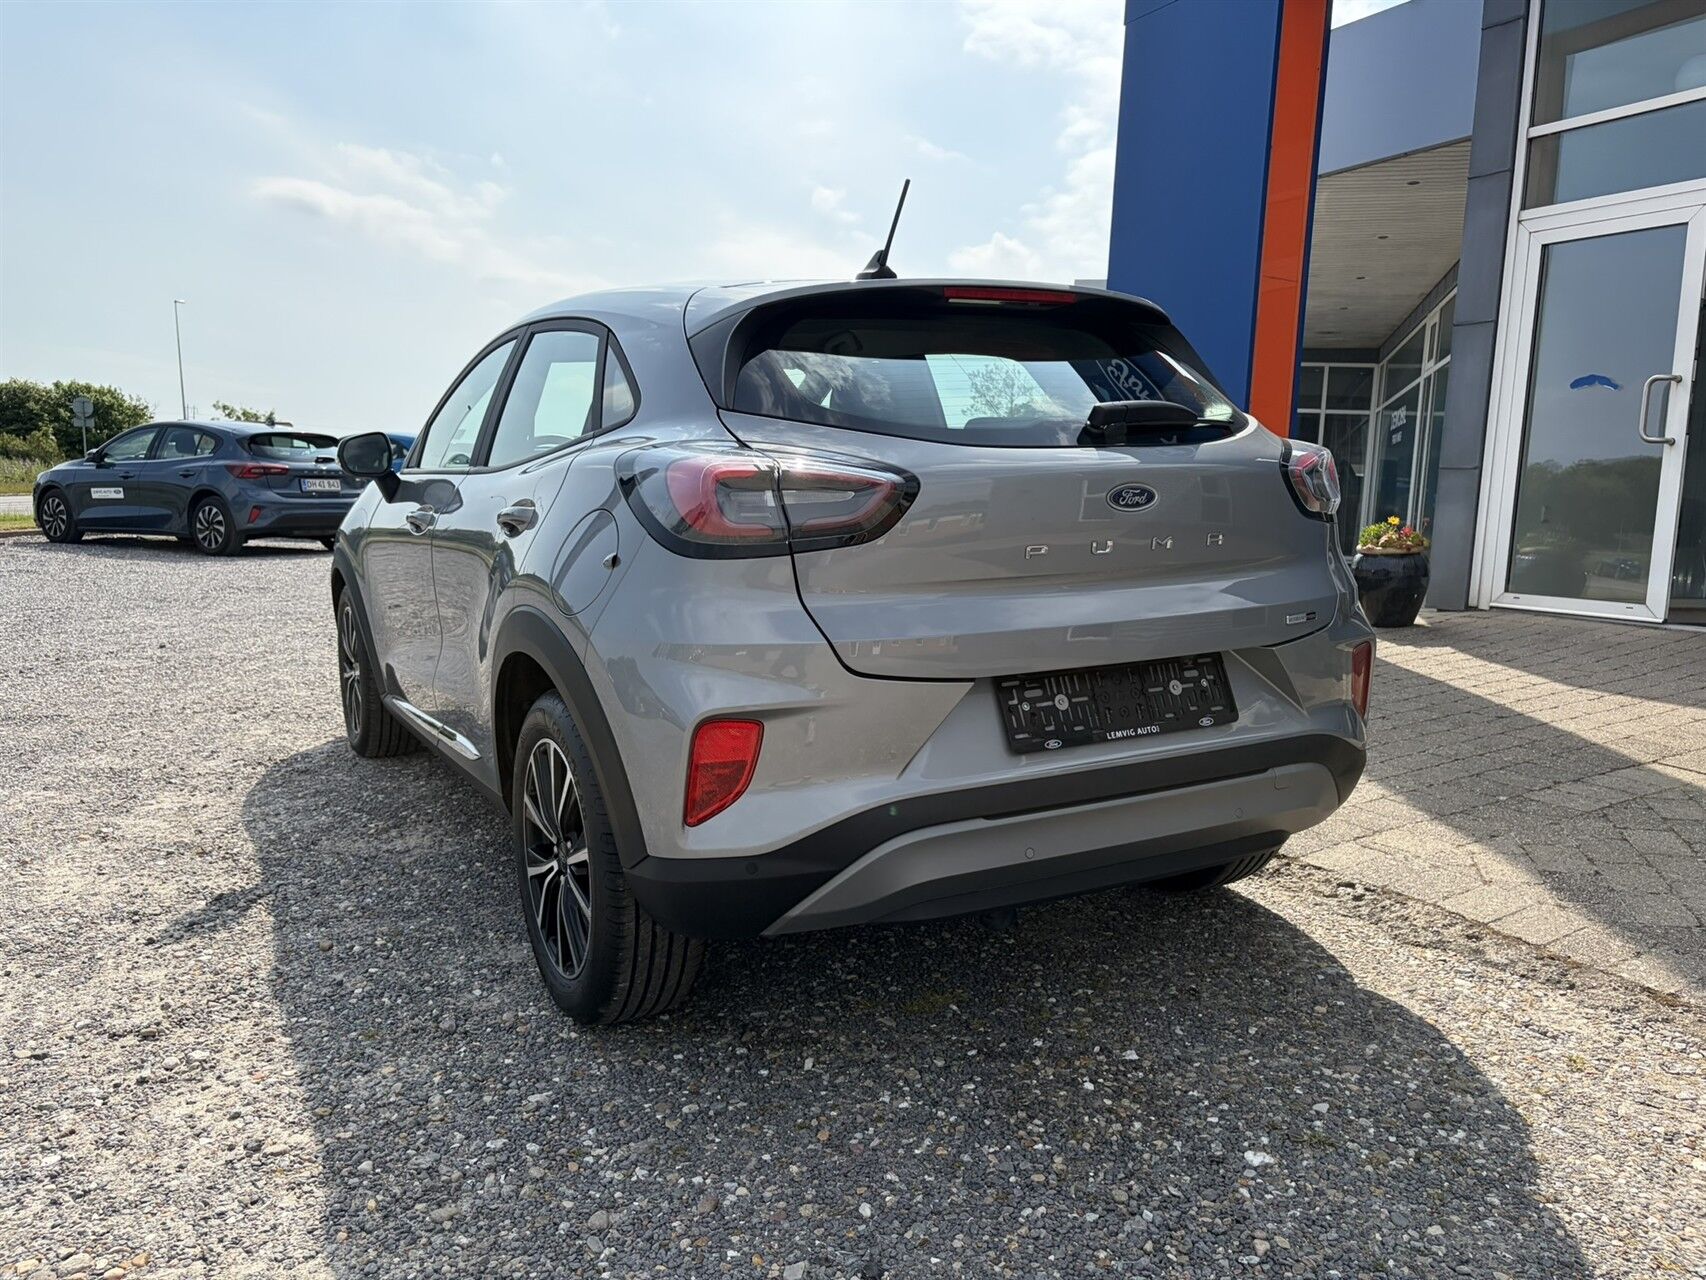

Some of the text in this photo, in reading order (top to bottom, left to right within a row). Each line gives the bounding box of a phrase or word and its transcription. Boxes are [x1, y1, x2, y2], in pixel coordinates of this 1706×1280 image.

[1119, 488, 1148, 505] Ford
[1025, 533, 1224, 560] PUMA
[1106, 728, 1136, 740] LEMVIG
